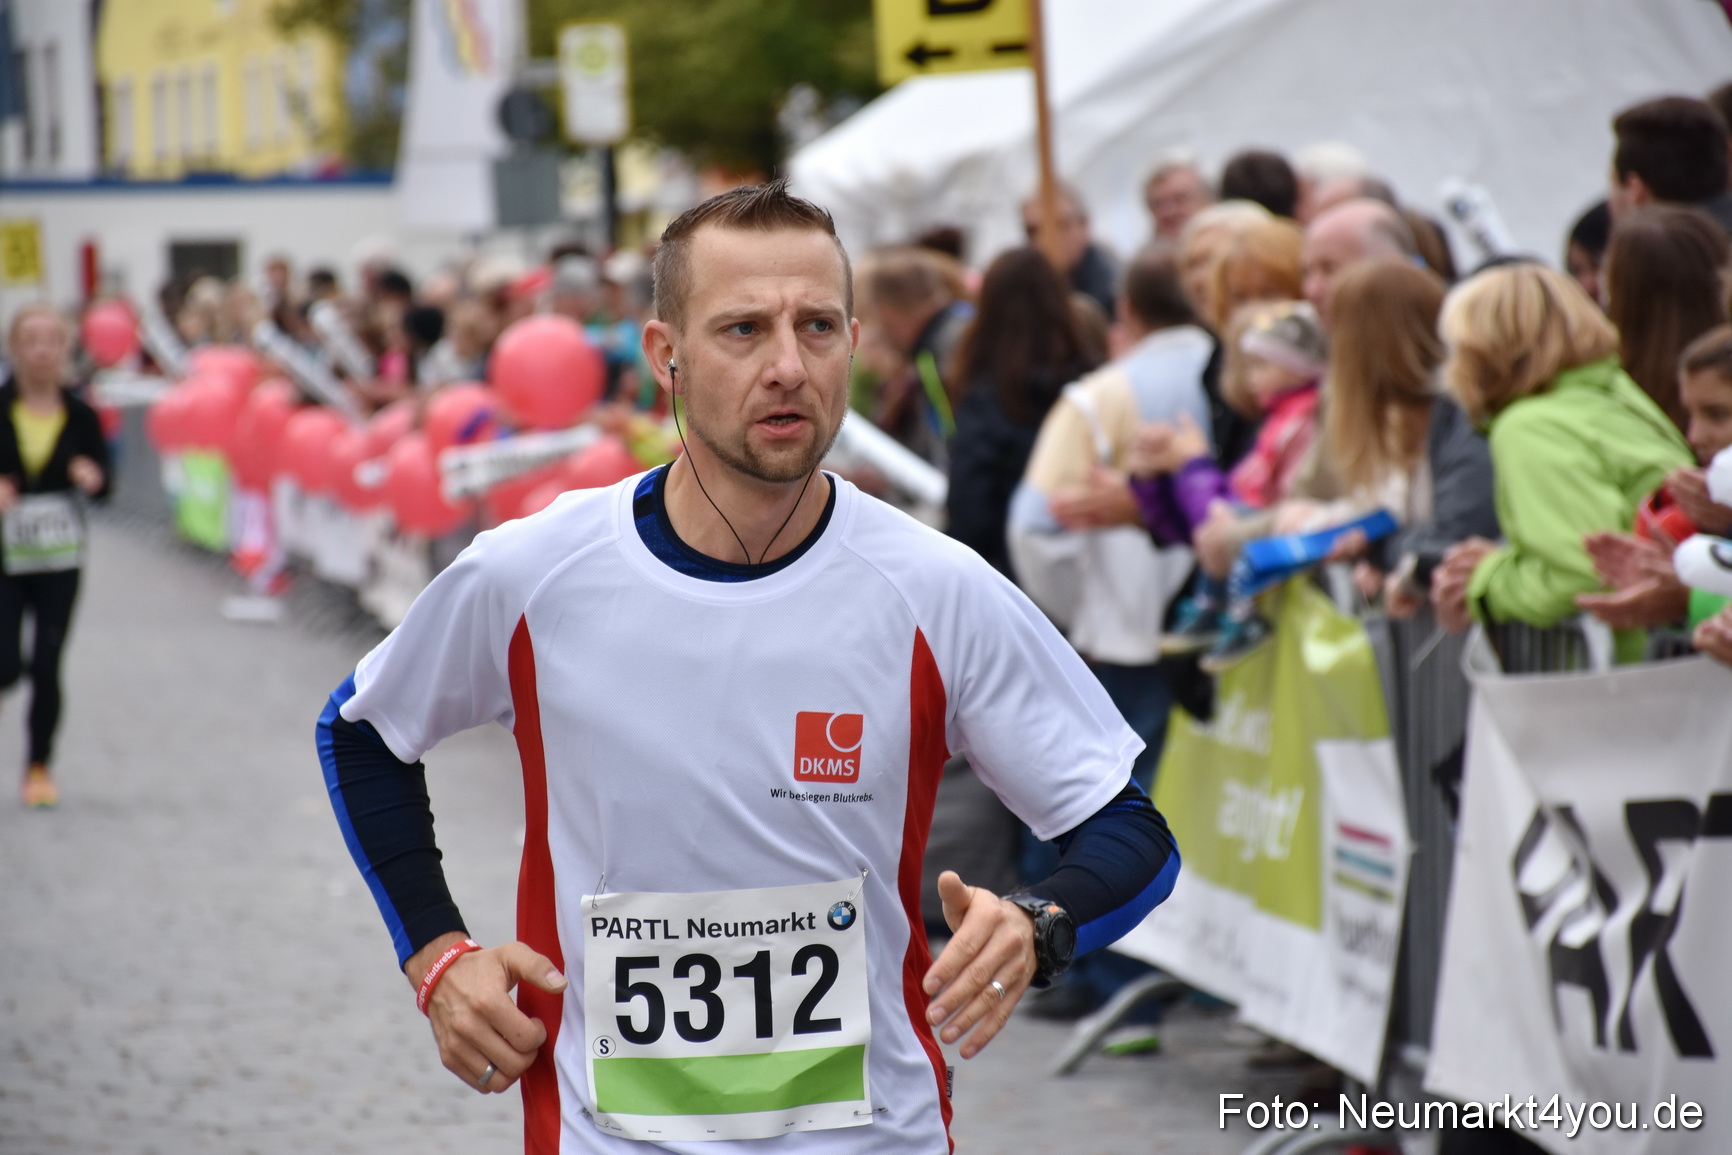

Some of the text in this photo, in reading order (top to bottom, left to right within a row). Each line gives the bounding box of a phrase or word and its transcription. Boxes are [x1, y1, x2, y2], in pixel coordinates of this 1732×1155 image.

[799, 757, 855, 777] DKMS
[770, 788, 874, 804] Wir besiegen Blutkrebs.
[590, 911, 816, 940] PARTL Neumarkt
[423, 947, 460, 986] Blutkrebs.
[614, 943, 843, 1045] 5312
